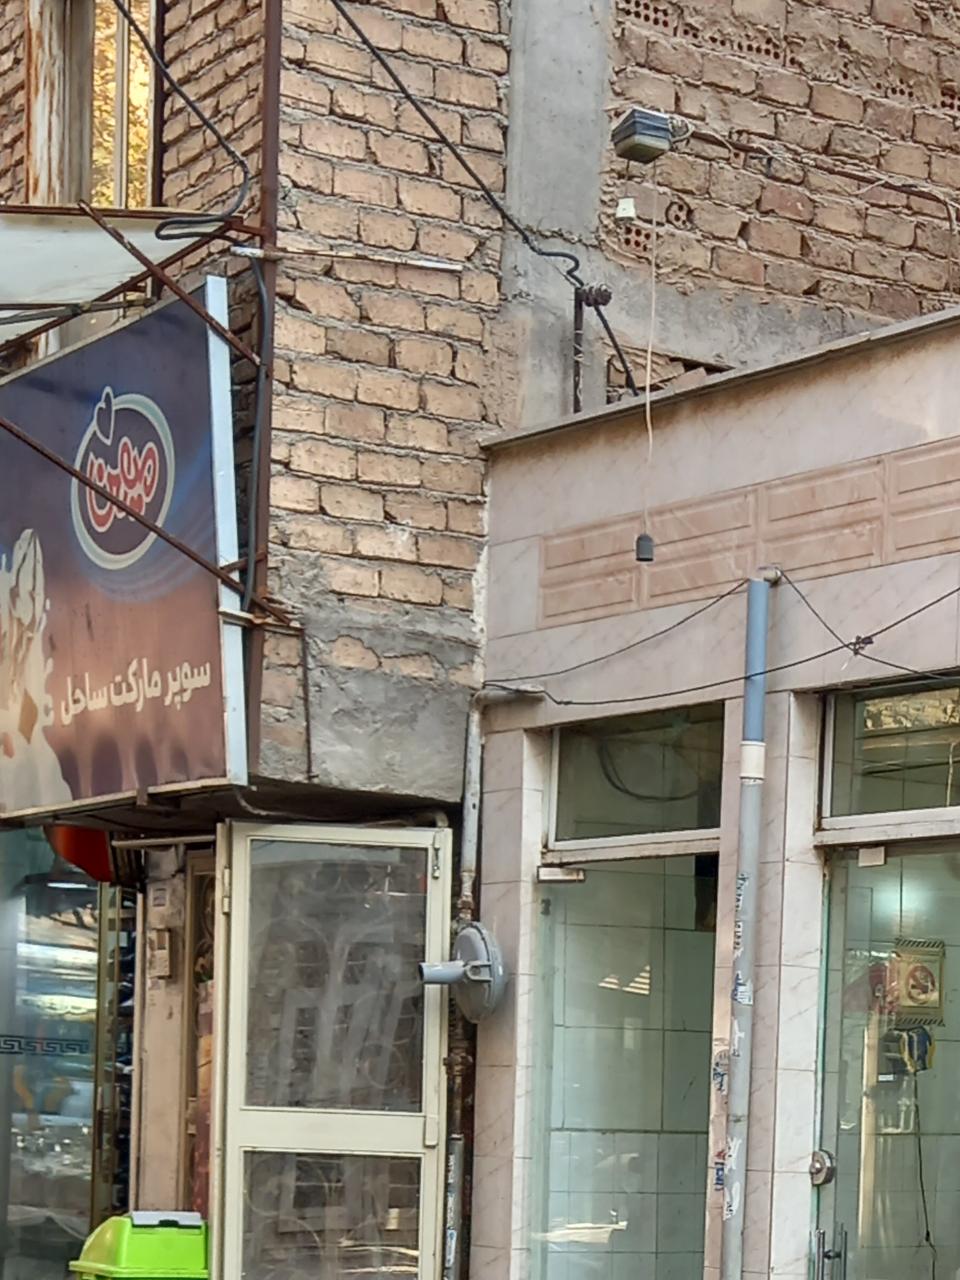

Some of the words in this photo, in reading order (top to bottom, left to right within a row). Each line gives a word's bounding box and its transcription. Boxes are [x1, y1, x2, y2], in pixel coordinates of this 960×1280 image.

[86, 436, 159, 533] میهن
[61, 672, 107, 725] ساحل
[110, 657, 161, 712] مارکت
[164, 662, 210, 710] سوپر
